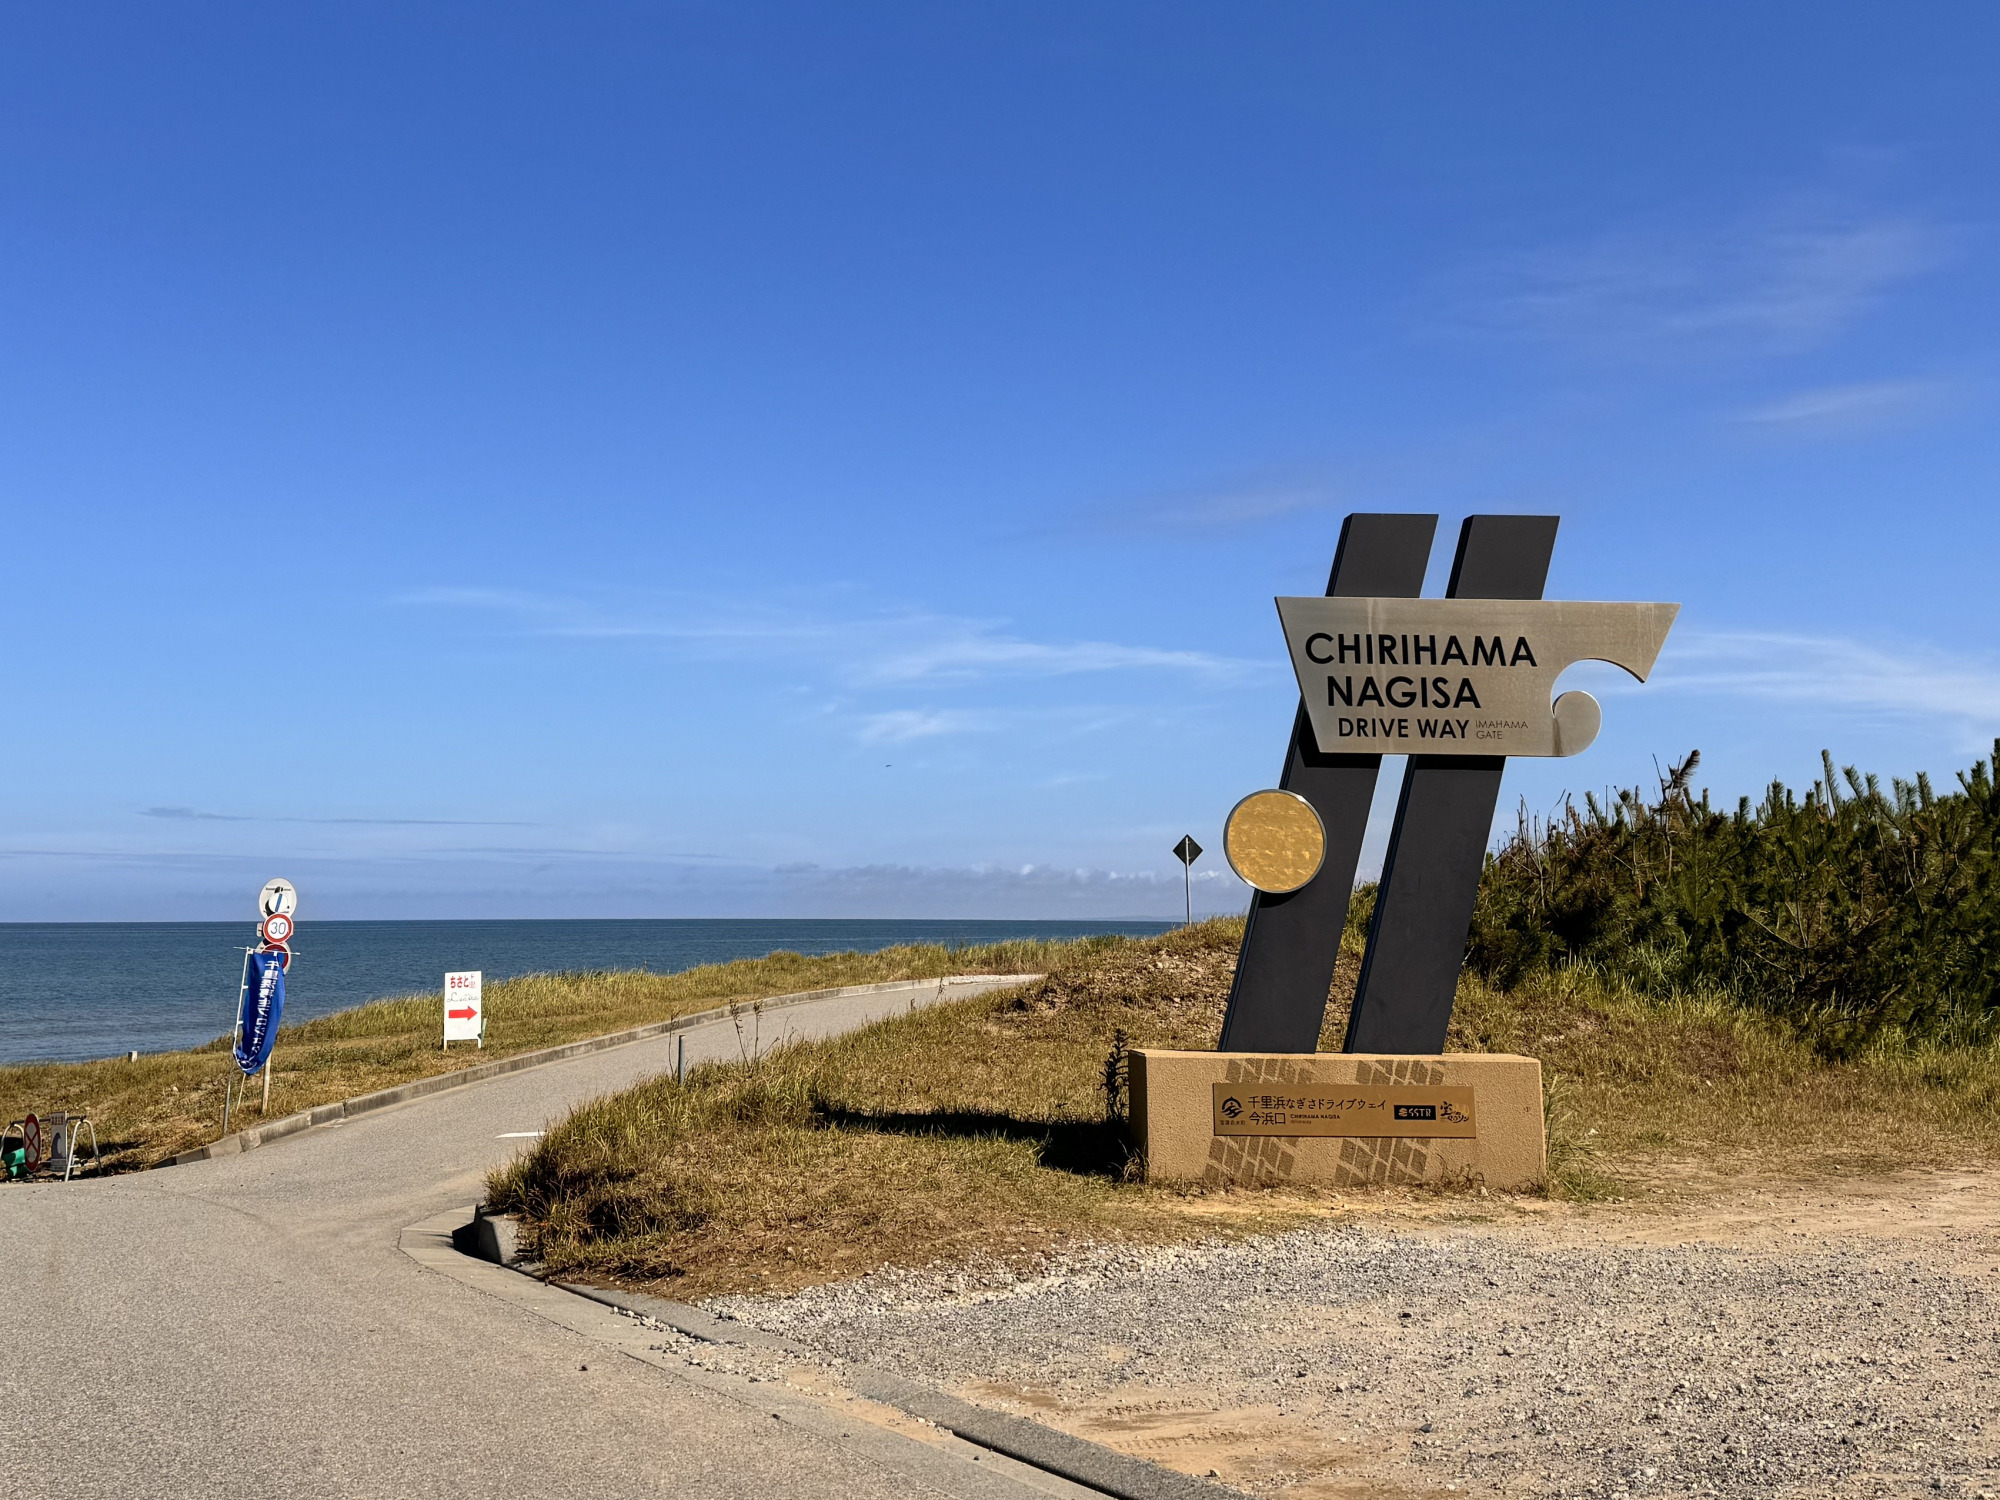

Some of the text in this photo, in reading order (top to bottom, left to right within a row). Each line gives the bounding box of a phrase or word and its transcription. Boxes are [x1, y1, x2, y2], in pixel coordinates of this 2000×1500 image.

[1305, 632, 1538, 667] CHIRIHAMA
[1327, 675, 1482, 709] NAGISA
[1338, 717, 1470, 739] DRIVE WAY
[1475, 720, 1528, 729] IMAHAMA
[1476, 730, 1503, 740] GATE
[270, 921, 287, 935] 30
[1248, 1095, 1386, 1111] 千里浜なぎさドライブウェイ
[1248, 1111, 1286, 1126] 今浜口
[1408, 1107, 1432, 1117] SSTR
